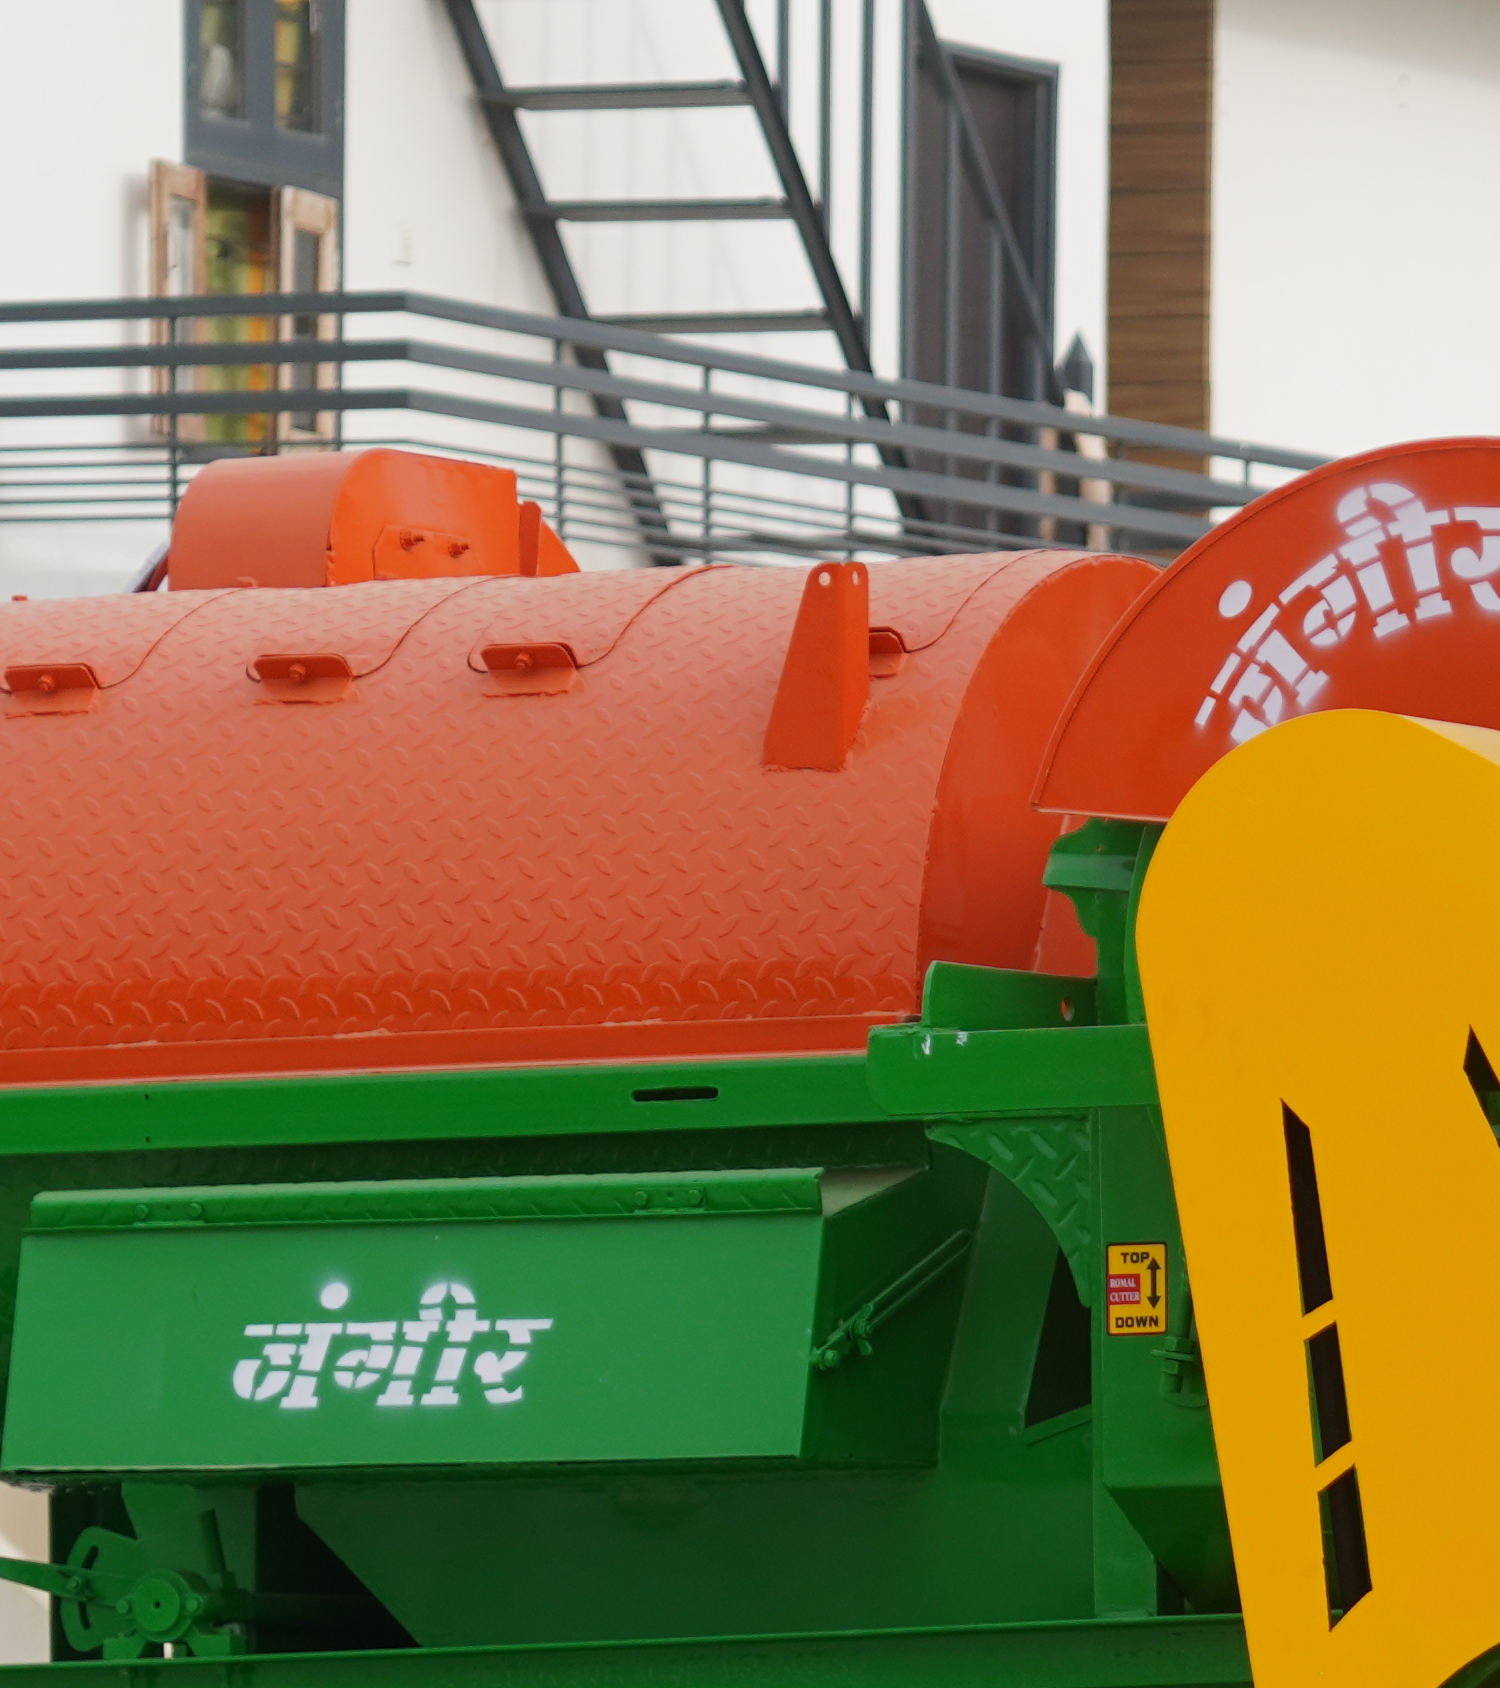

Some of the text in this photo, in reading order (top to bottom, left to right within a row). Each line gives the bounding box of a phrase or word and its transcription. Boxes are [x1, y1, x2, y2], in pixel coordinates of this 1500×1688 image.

[1120, 1252, 1150, 1264] TOP
[1109, 1291, 1140, 1302] CUTTER
[1115, 1315, 1159, 1328] DOWN
[232, 1282, 554, 1409] जंगीर
